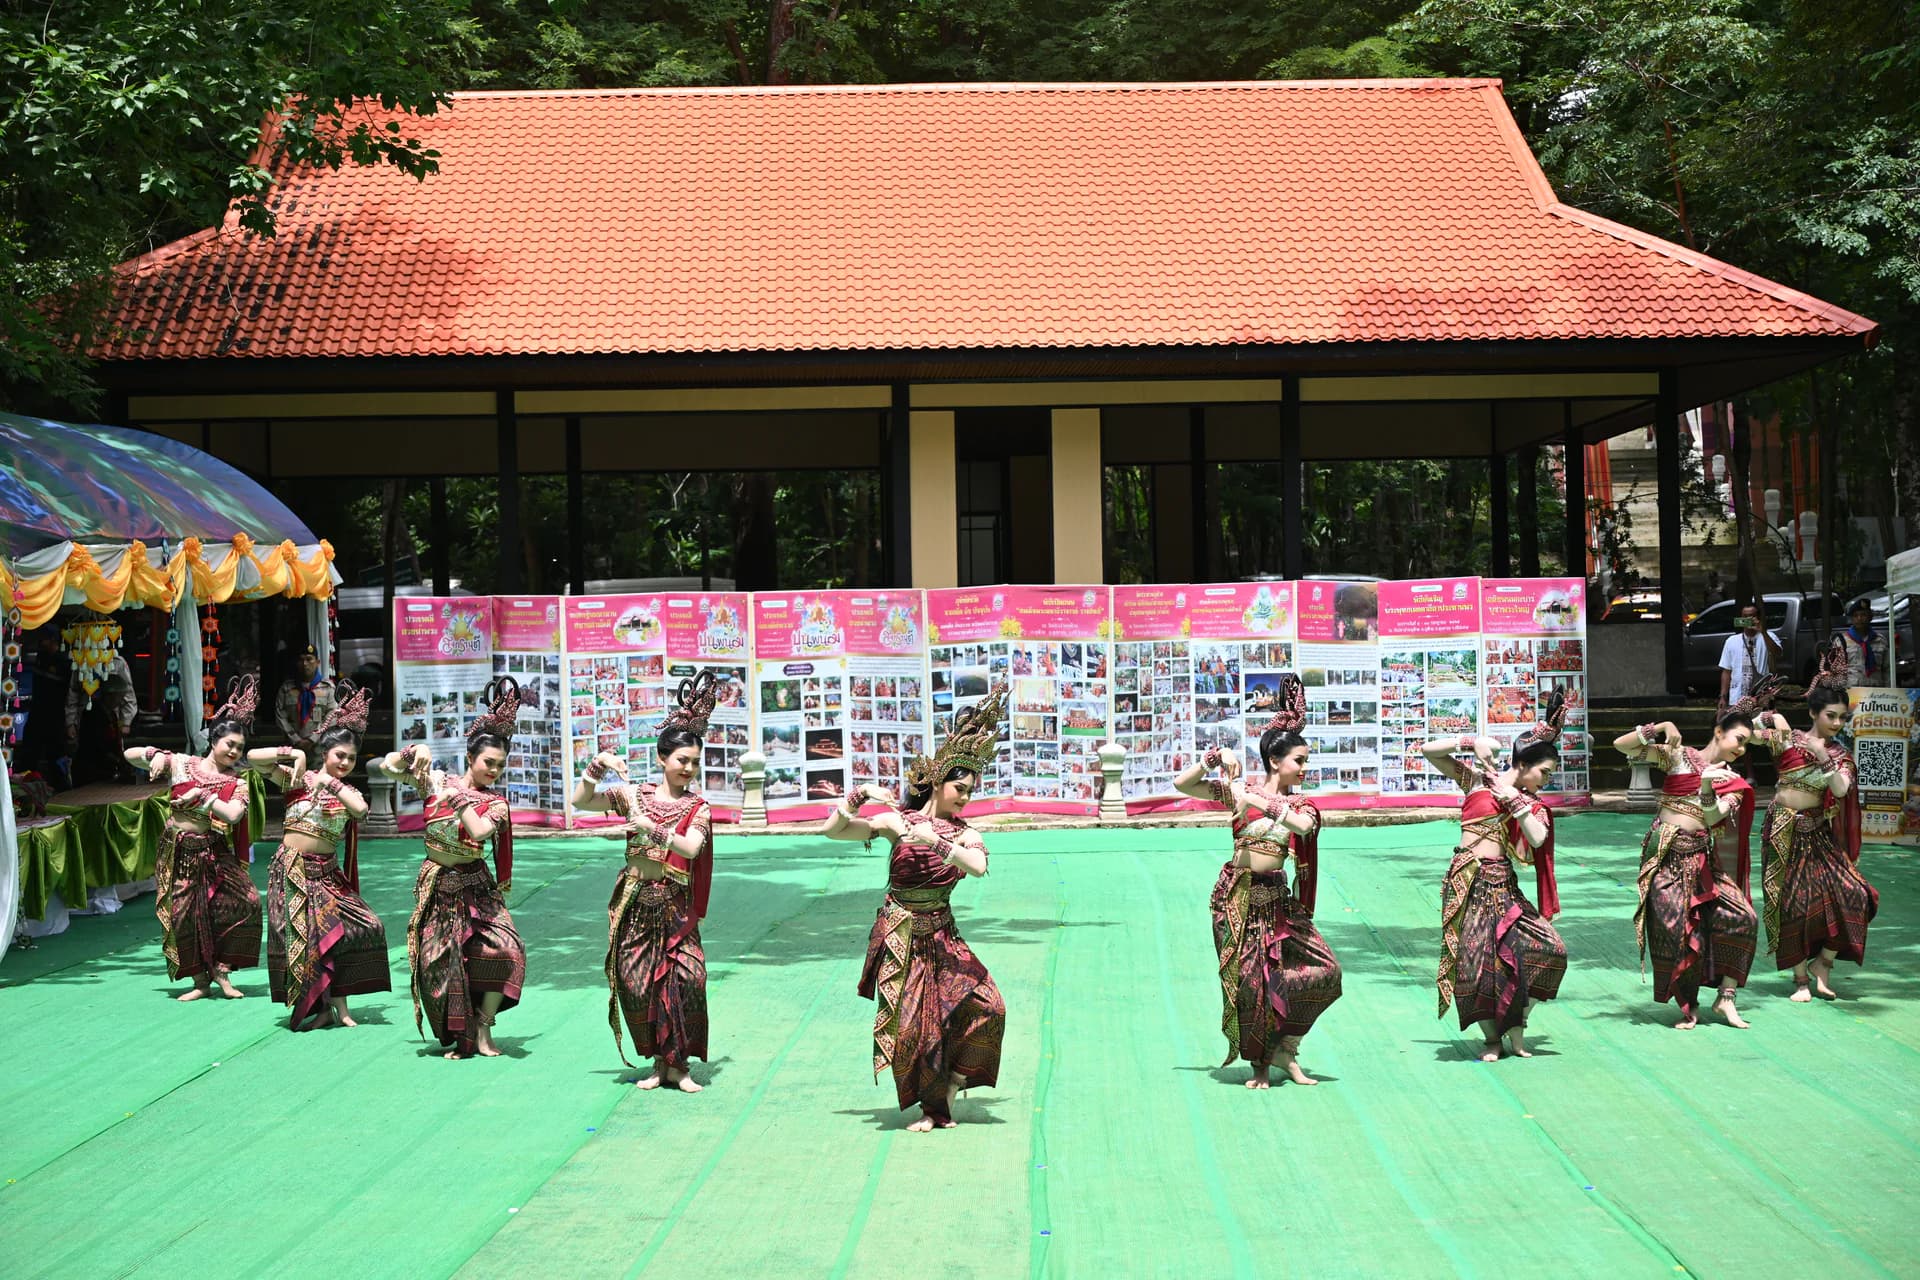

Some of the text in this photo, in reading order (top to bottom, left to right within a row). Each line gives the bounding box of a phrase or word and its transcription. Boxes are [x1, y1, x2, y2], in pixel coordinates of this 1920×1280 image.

[1859, 701, 1898, 712] ไปไหนดี
[1852, 713, 1914, 729] ศรีสะเกษ
